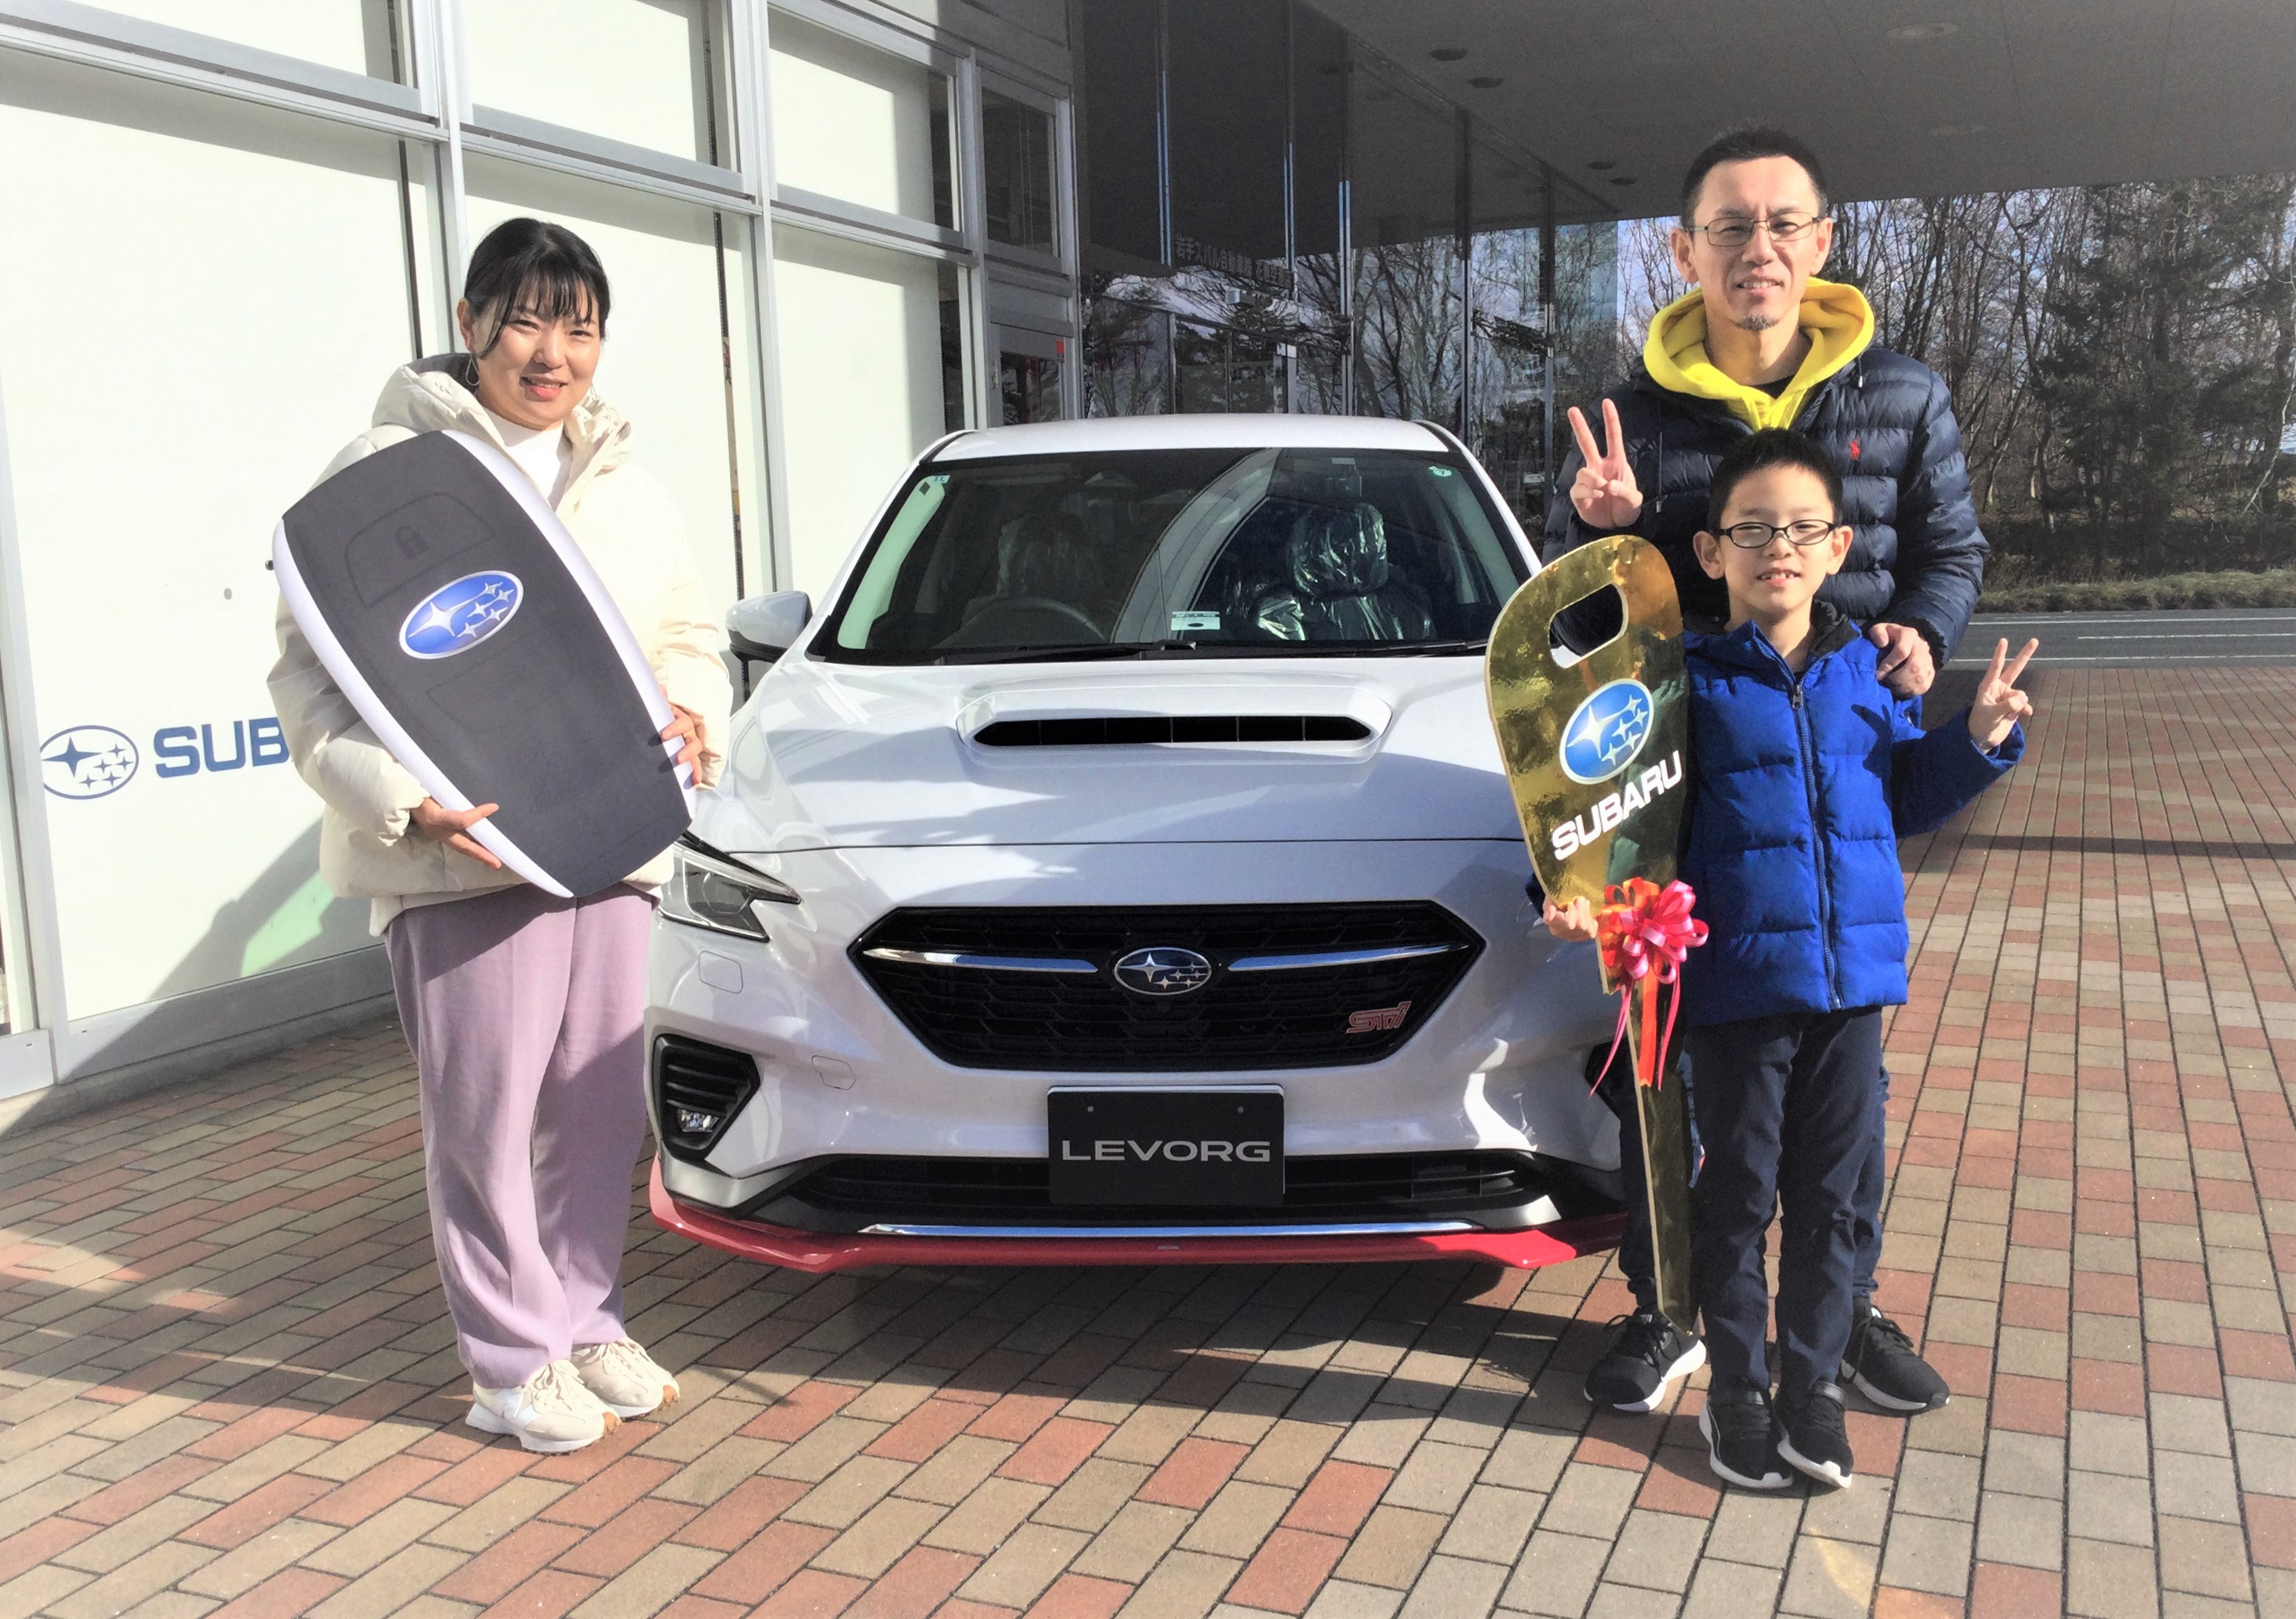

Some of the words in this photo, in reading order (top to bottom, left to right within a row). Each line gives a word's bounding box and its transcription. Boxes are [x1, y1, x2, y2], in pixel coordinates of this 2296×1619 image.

[154, 717, 290, 778] SUB
[1551, 750, 1682, 860] SUBARU
[1062, 1140, 1270, 1162] LEVORG
